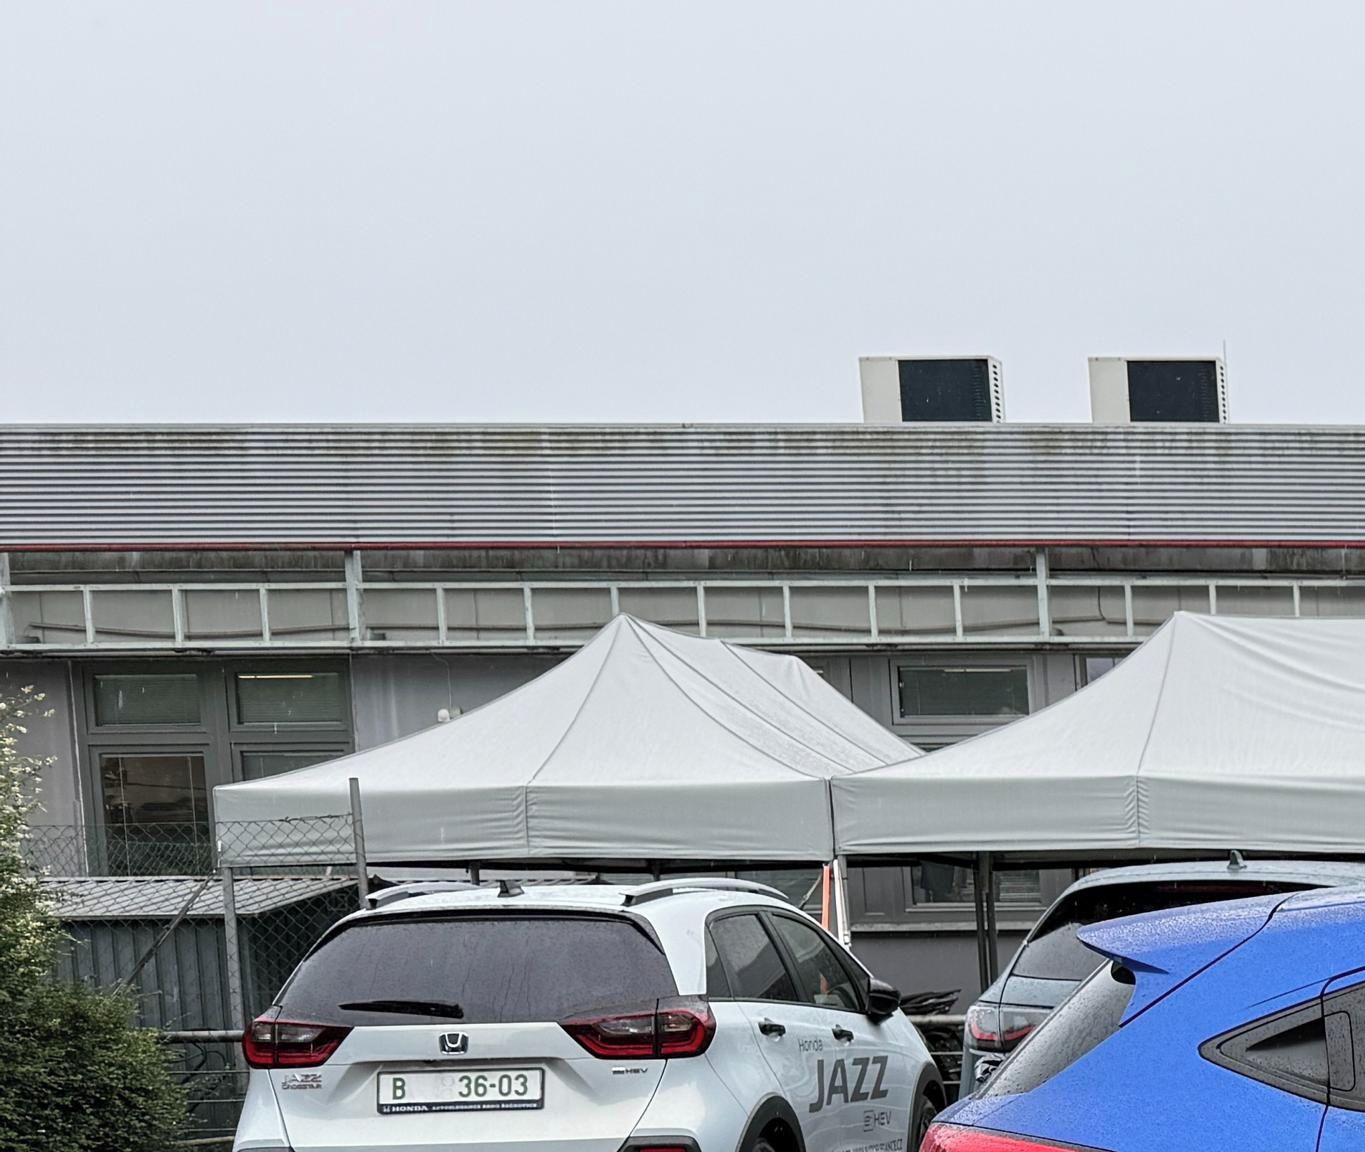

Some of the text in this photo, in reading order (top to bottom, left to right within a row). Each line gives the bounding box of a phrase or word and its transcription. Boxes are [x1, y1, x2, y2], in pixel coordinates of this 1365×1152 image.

[392, 1073, 528, 1100] B 36-03
[809, 1055, 889, 1113] JAZZ
